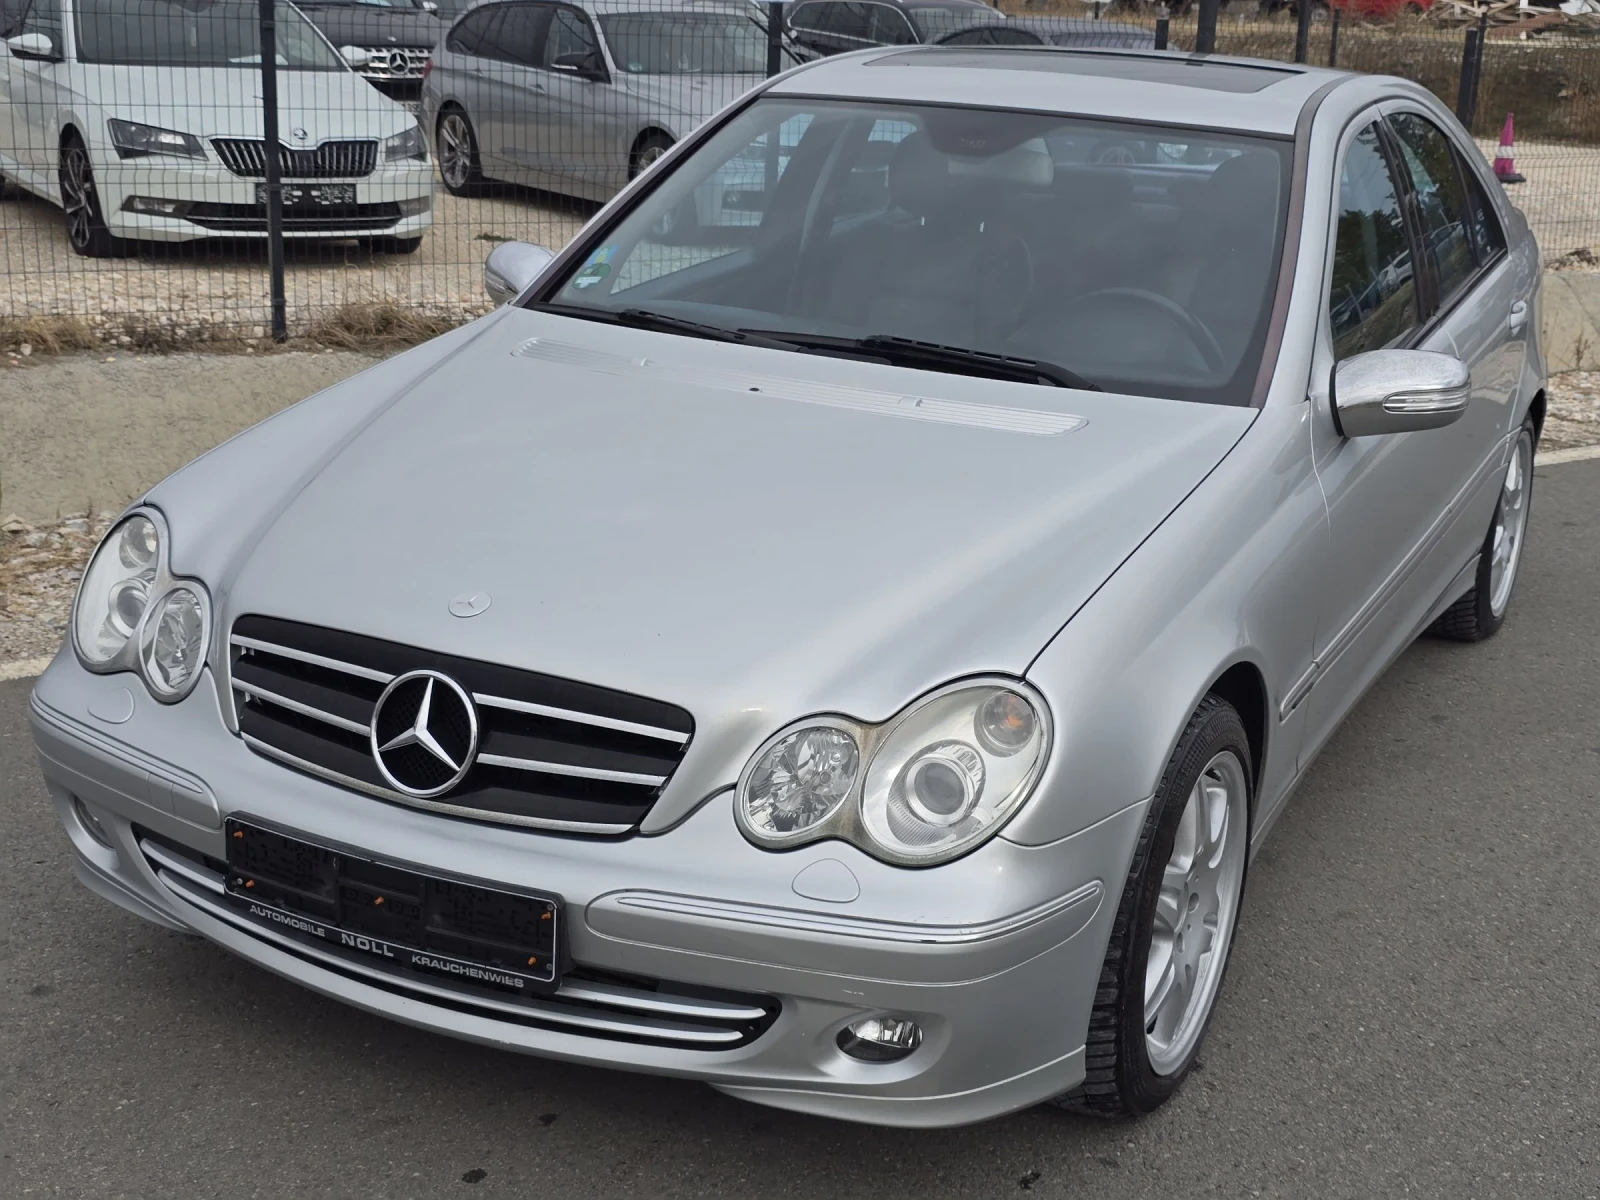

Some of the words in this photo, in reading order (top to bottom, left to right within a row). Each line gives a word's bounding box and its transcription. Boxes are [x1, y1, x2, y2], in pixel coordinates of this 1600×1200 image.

[249, 904, 326, 938] AUTOMOBILE
[341, 933, 394, 957] NOLL
[411, 954, 524, 988] KRAUCHENWIES
